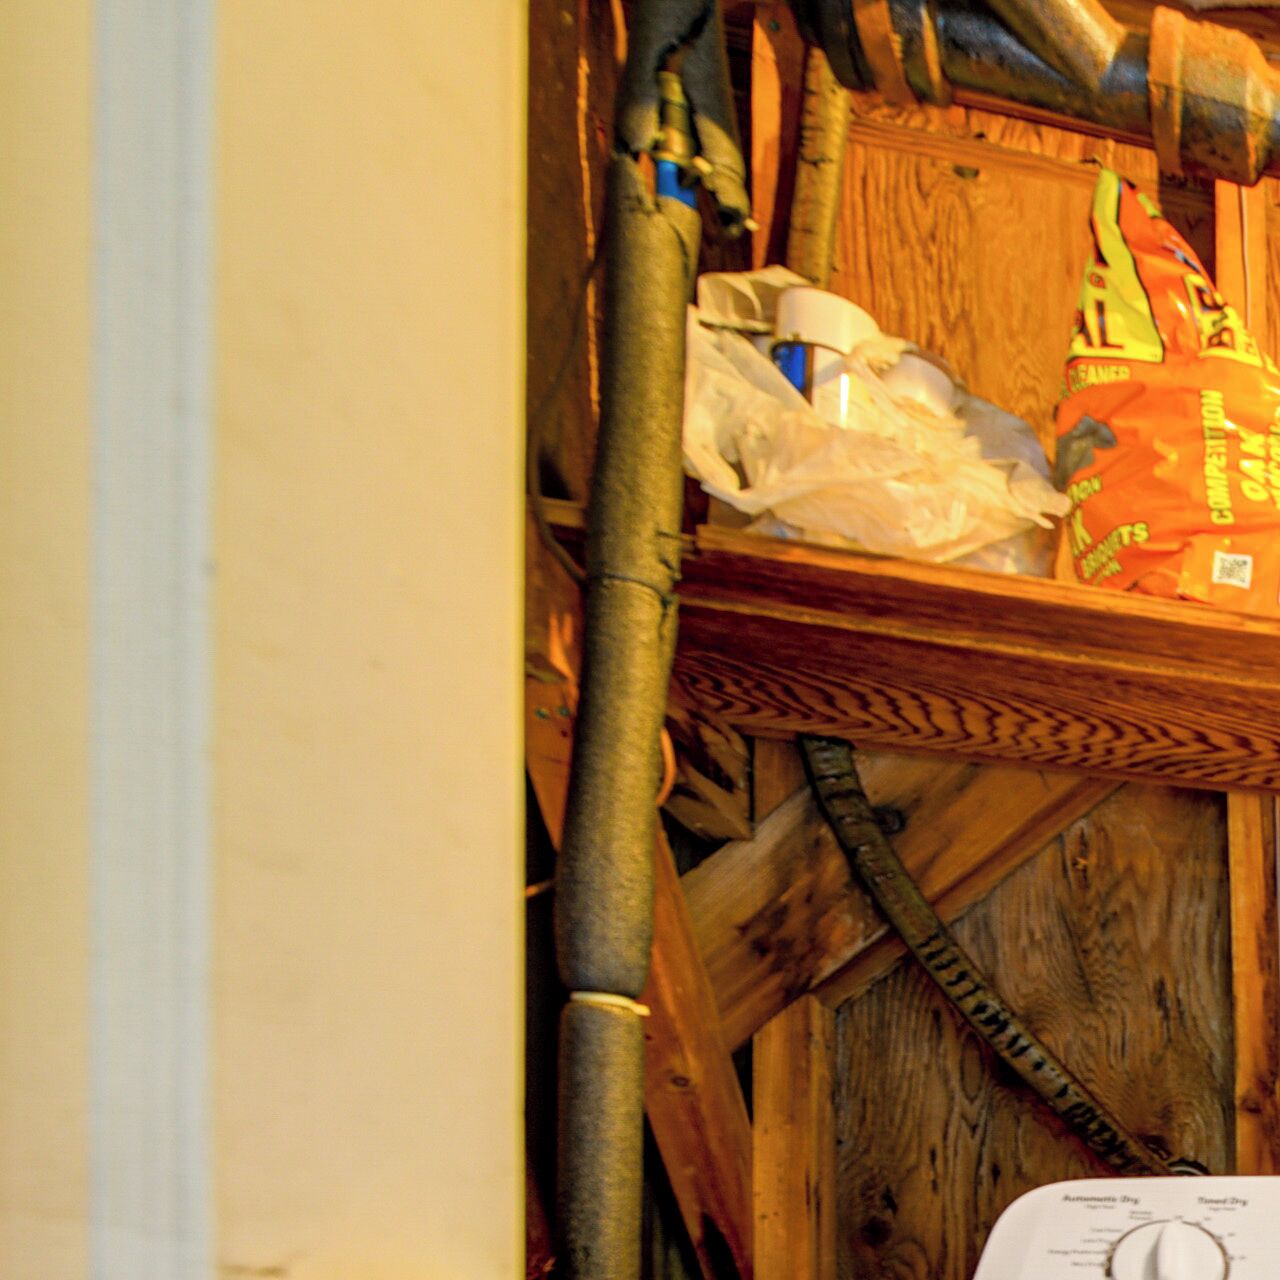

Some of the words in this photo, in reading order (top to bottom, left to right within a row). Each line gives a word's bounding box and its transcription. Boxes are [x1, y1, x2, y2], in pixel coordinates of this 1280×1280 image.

[1238, 430, 1269, 502] OAK
[1062, 1194, 1118, 1203] Automatic
[1120, 1194, 1141, 1205] Dry
[1230, 1197, 1249, 1207] Dry
